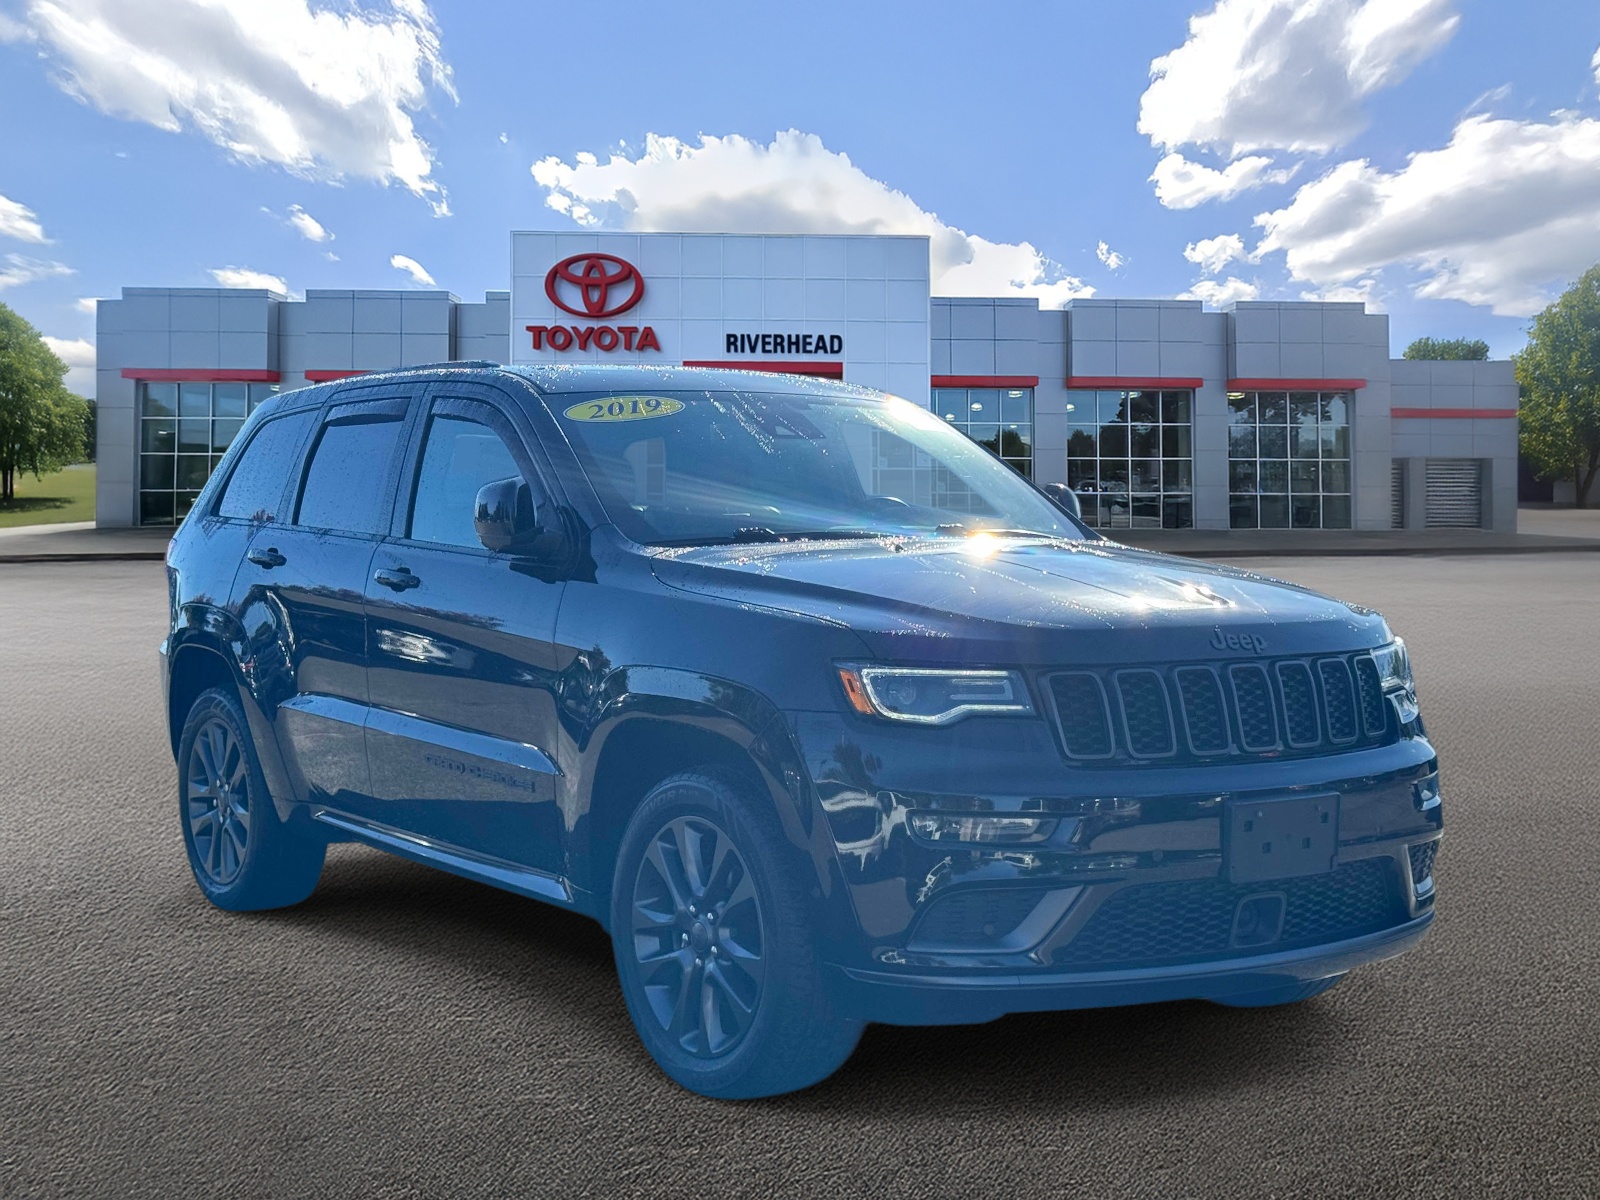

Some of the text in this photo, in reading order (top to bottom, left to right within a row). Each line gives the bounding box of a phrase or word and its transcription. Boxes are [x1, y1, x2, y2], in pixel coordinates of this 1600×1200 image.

[526, 325, 661, 352] TOYOTA
[725, 333, 843, 355] RIVERHEAD
[588, 398, 660, 419] 2019
[1209, 629, 1267, 655] Jeep
